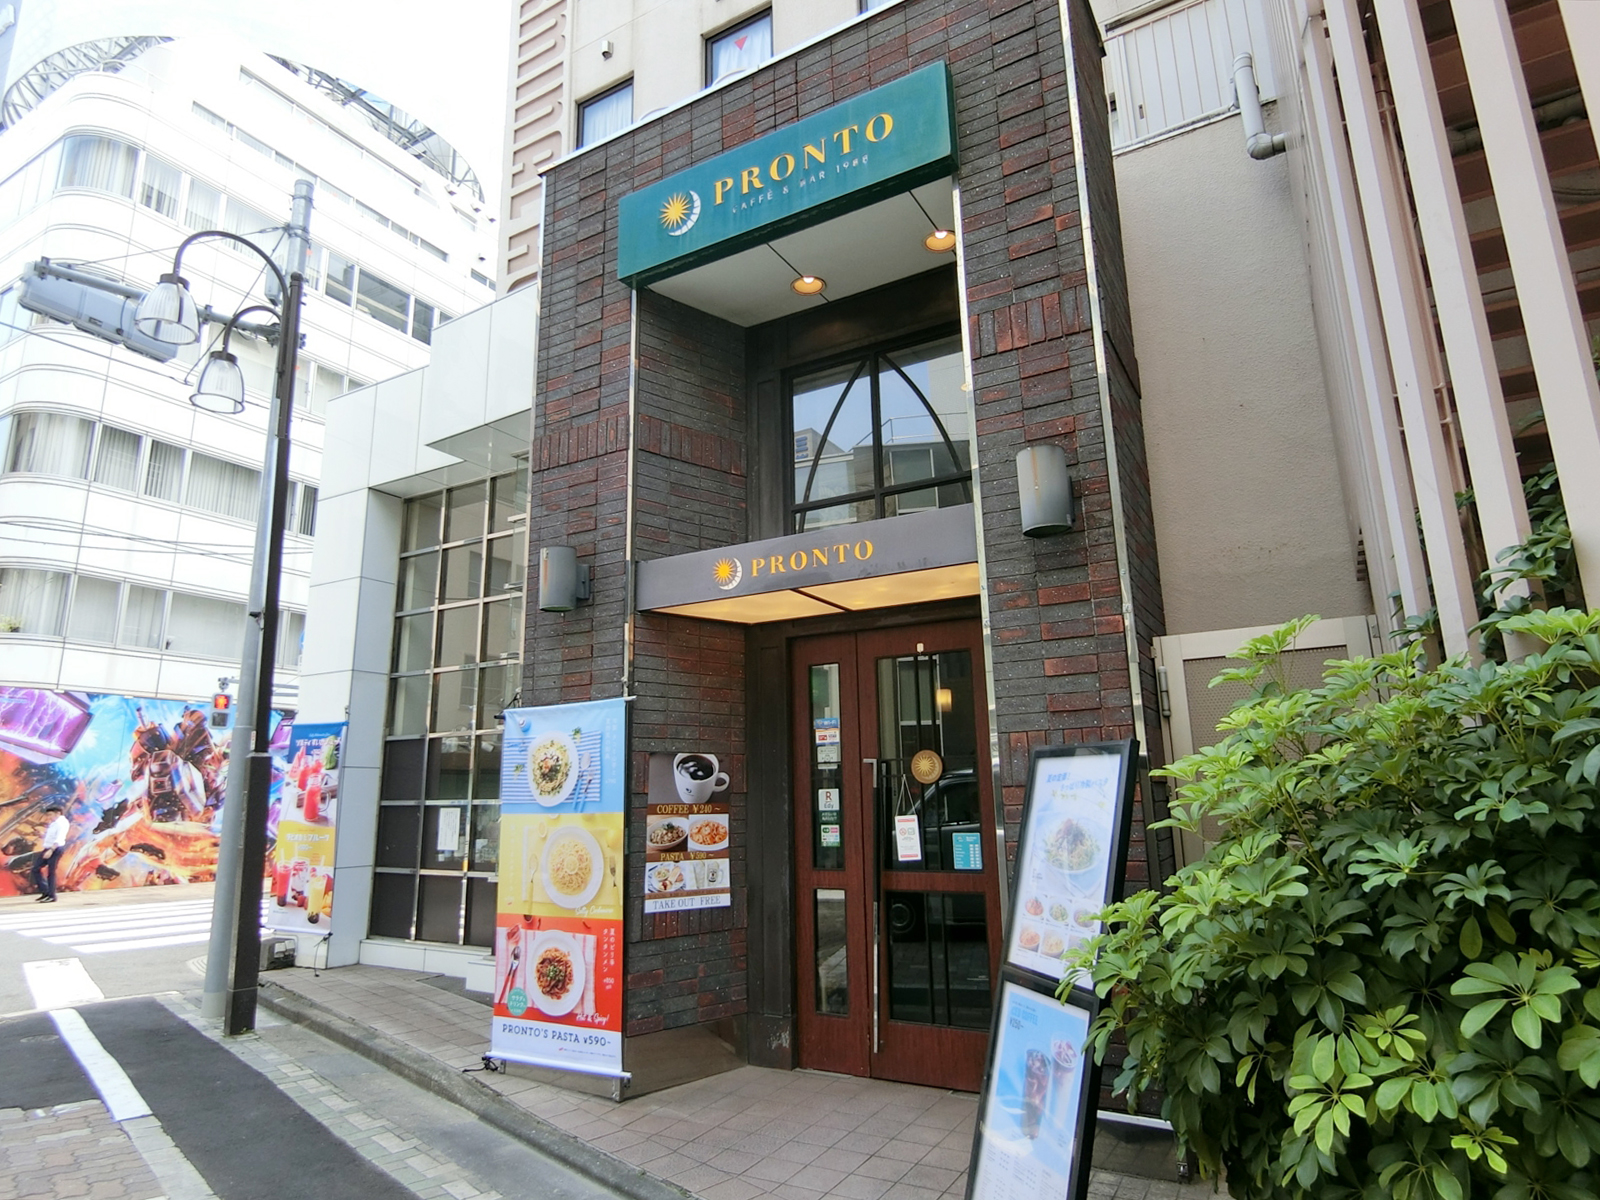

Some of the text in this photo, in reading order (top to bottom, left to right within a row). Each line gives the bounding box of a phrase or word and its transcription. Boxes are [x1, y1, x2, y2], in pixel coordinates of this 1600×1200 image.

[713, 112, 894, 205] PRONTO
[782, 186, 789, 195] &
[835, 154, 869, 174] 1988
[750, 539, 874, 577] PRONTO
[656, 804, 690, 814] COFFEE
[660, 852, 685, 861] PASTA
[652, 895, 721, 910] TAKE OUT FREE
[502, 1023, 549, 1039] PRONTO'S
[551, 1030, 580, 1044] PASTA
